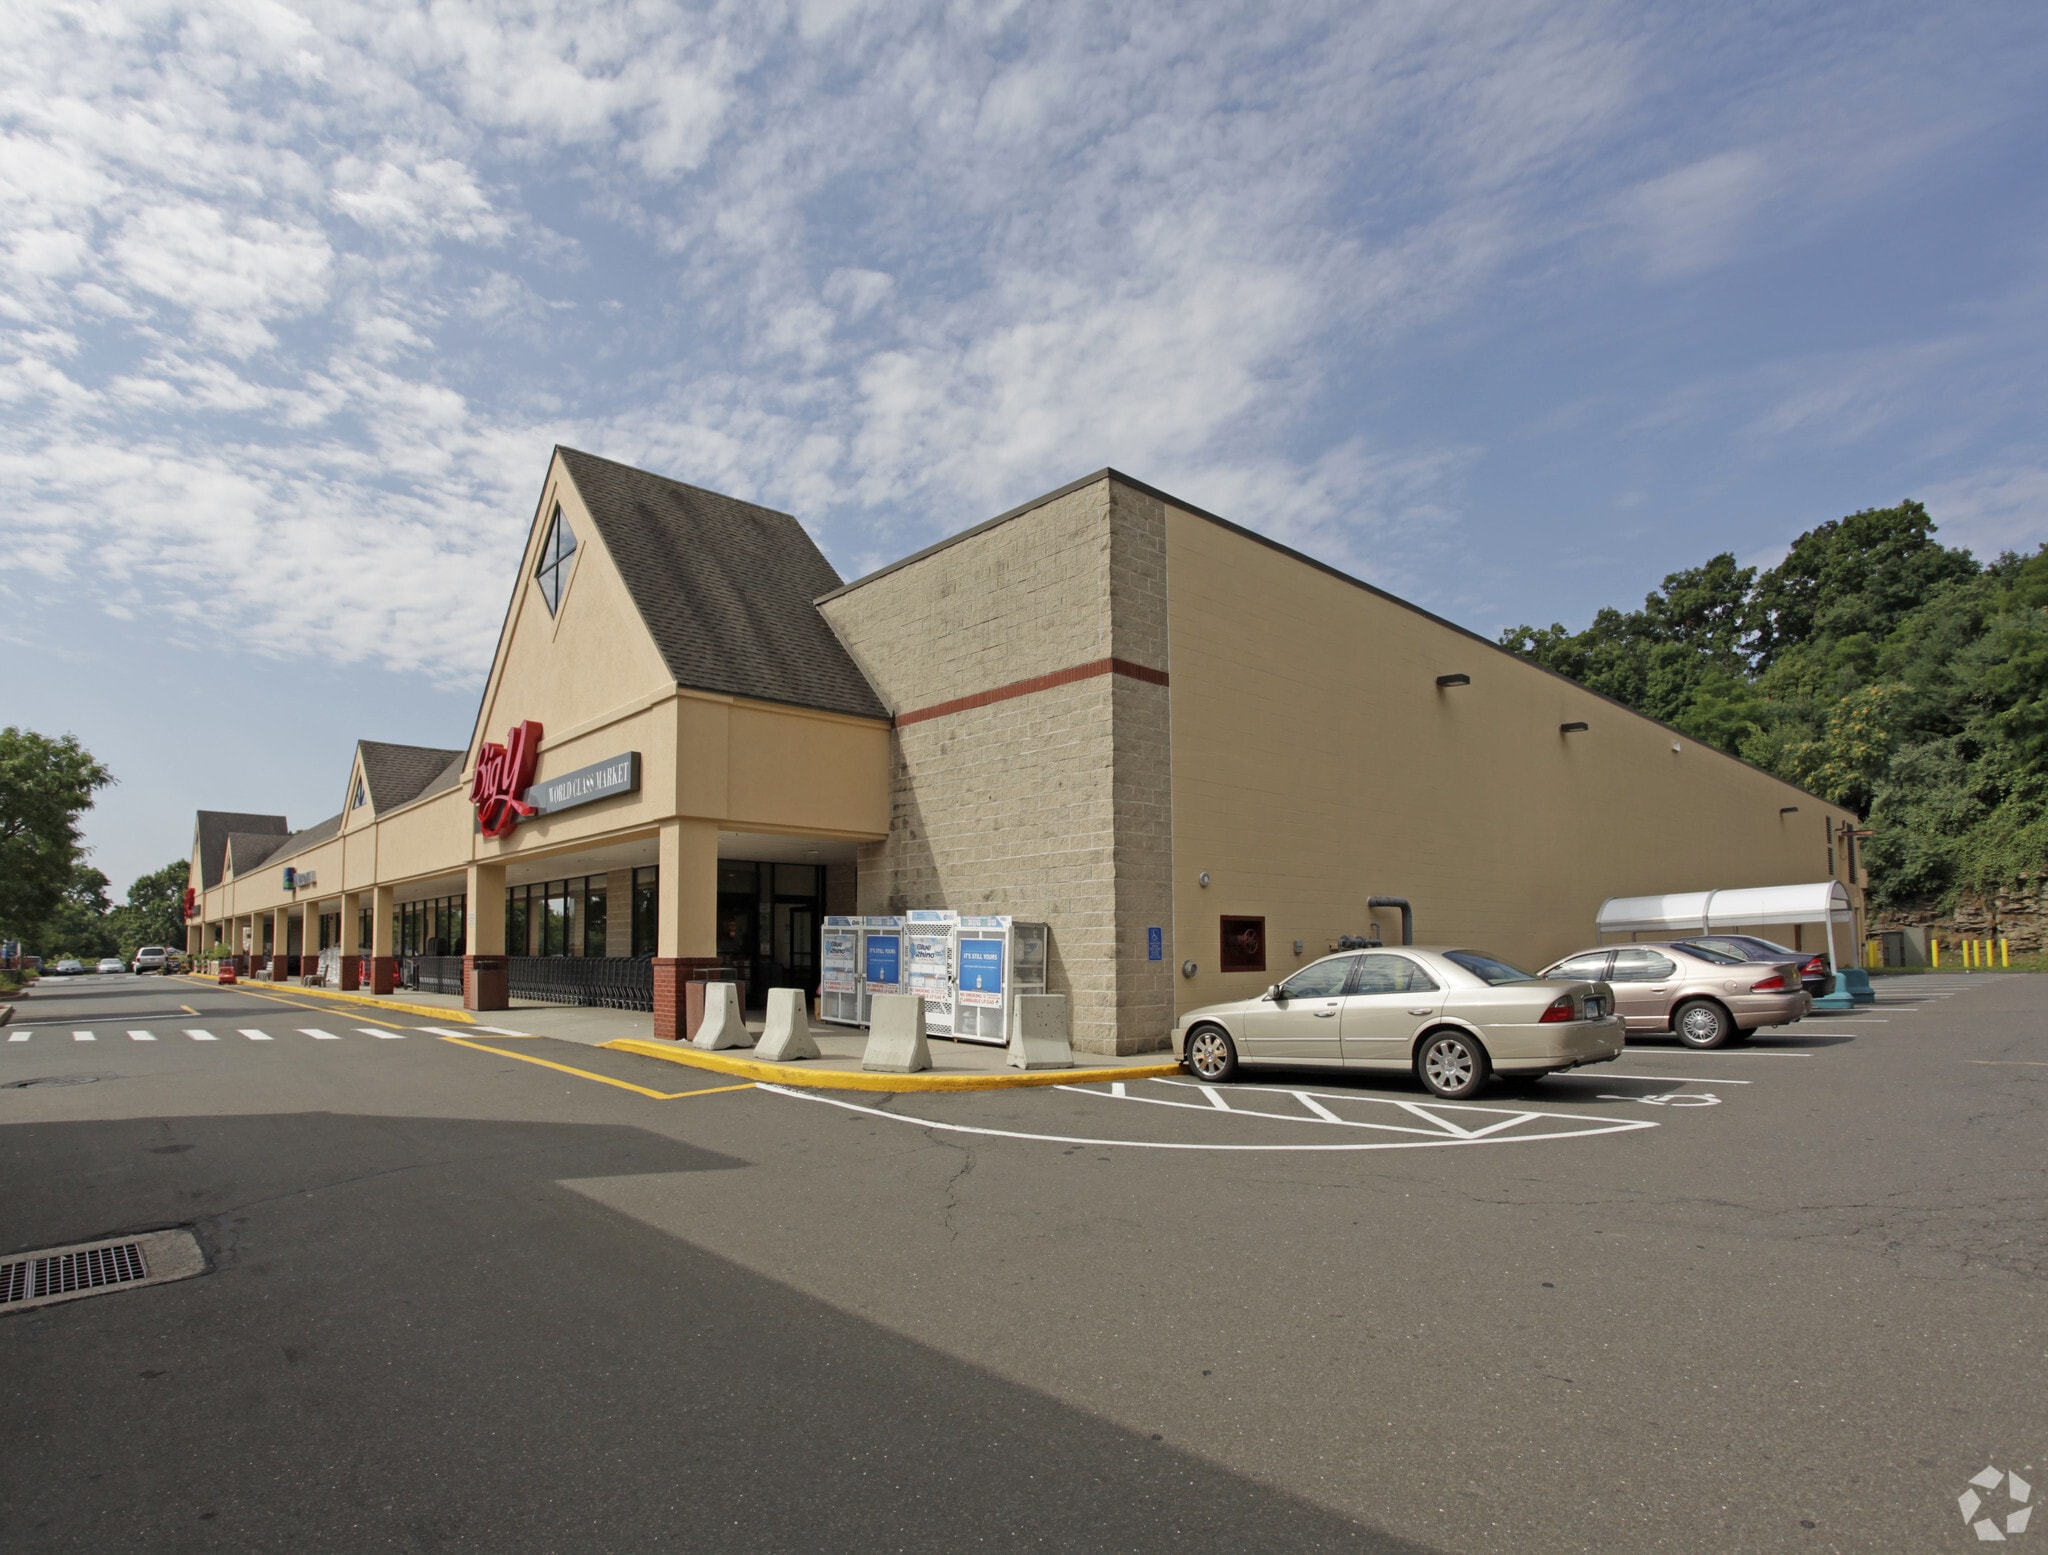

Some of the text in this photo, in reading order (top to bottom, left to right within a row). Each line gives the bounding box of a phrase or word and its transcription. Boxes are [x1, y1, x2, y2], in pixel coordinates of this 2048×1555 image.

[469, 720, 543, 838] Big Y
[549, 762, 629, 803] WORLD CLASS MARKET
